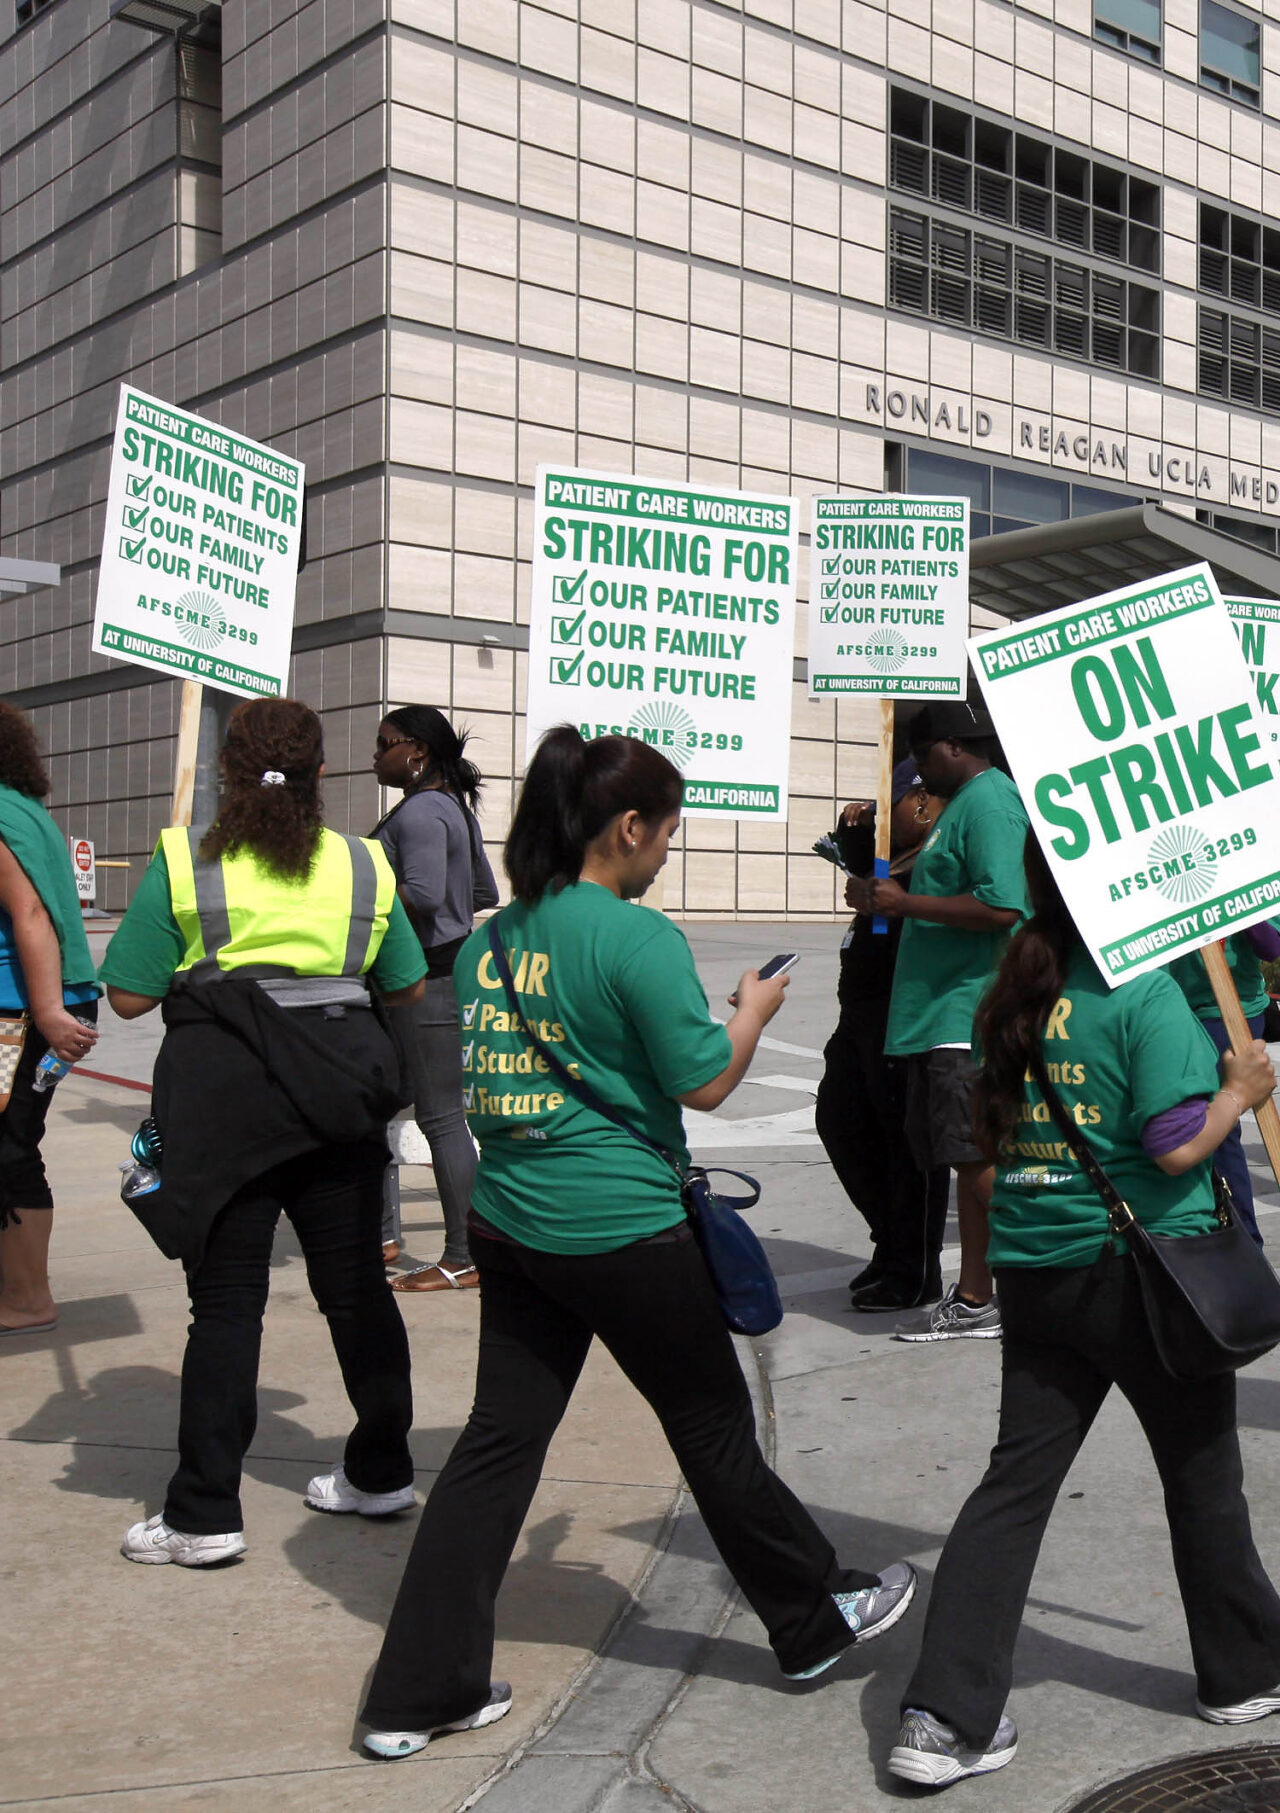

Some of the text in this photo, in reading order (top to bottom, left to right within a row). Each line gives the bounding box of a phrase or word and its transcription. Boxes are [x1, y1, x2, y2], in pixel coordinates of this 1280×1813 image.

[129, 399, 296, 484] PATIENT CARE WORKERS
[866, 384, 992, 436] RONALD
[1020, 422, 1128, 471] REAGAN
[1149, 452, 1212, 490] UCLA
[122, 428, 296, 527] STRIKING FOR
[153, 487, 287, 555] OUR PATIENTS
[549, 481, 787, 530] PATIENT CARE WORKERS
[819, 503, 962, 518] PATIENT CARE WORKERS
[150, 517, 264, 575] OUR FAMILY
[543, 517, 789, 584] STRIKING FOR
[816, 524, 964, 551] STRIKING FOR
[147, 548, 269, 608] OUR FUTURE
[843, 559, 958, 577] OUR PATIENTS
[590, 580, 779, 625] OUR PATIENTS
[842, 584, 938, 601] OUR FAMILY
[138, 594, 257, 645] AFSCME 3299
[841, 608, 944, 625] OUR FUTURE
[983, 580, 1209, 673] PATIENT CARE WORKERS
[104, 629, 278, 695] AT UNIVERSITY OF CALIFORNIA
[588, 621, 746, 660] OUR FAMILY
[837, 645, 937, 657] AFSCME 3299
[587, 661, 755, 700] OUR FUTURE
[815, 679, 958, 691] AT UNIVERSITY OF CALIFORNIA
[1070, 636, 1177, 741] ON
[686, 733, 742, 751] 3299
[686, 786, 775, 807] CALIFORNIA
[1034, 702, 1273, 861] STRIKE
[78, 883, 91, 891] ONLY
[1108, 827, 1258, 902] AFSCME 3299
[1107, 950, 1126, 969] AT
[1124, 914, 1199, 963] UNIVERSITY
[1202, 902, 1223, 926] OF
[477, 1045, 582, 1081] Studes
[478, 1087, 564, 1116] Future
